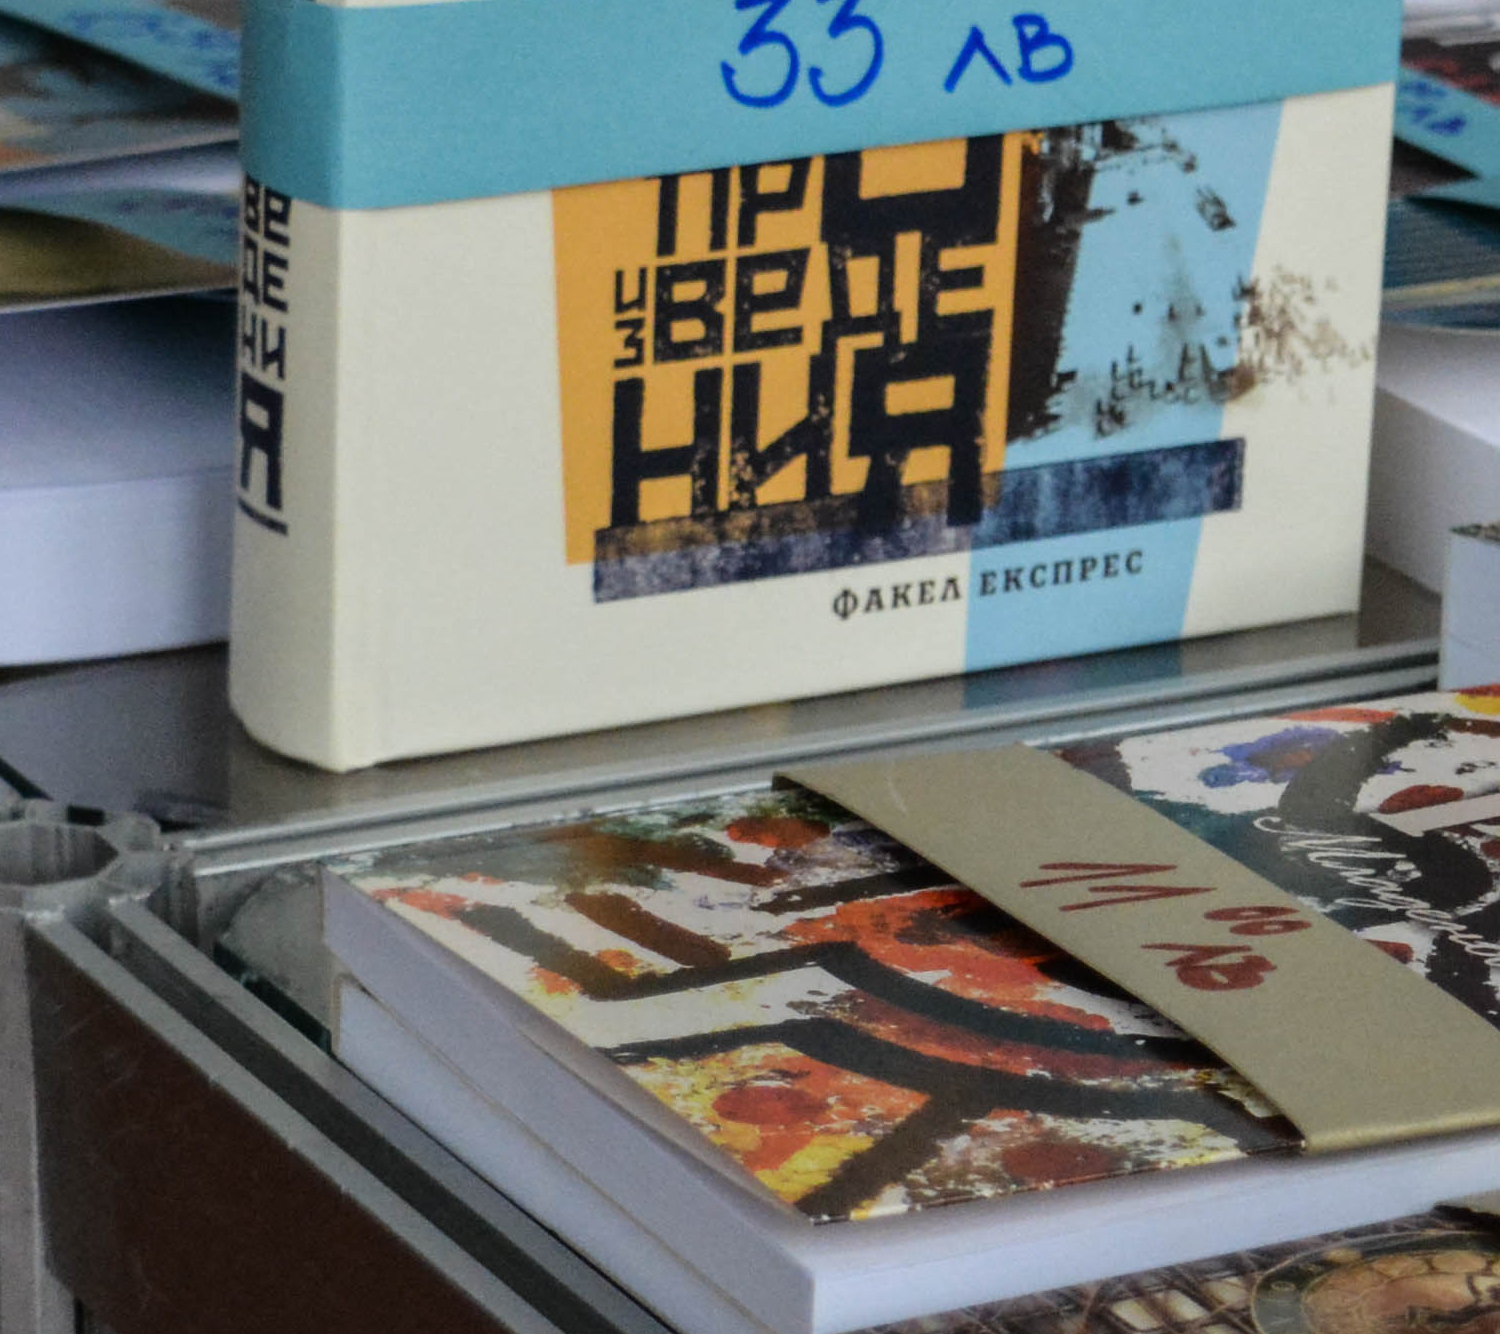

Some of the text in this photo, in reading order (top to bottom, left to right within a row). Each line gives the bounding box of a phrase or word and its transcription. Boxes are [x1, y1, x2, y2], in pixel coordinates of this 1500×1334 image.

[943, 12, 1075, 94] лв
[831, 549, 1146, 622] ФАКЕЛ ЕКСПРЕС
